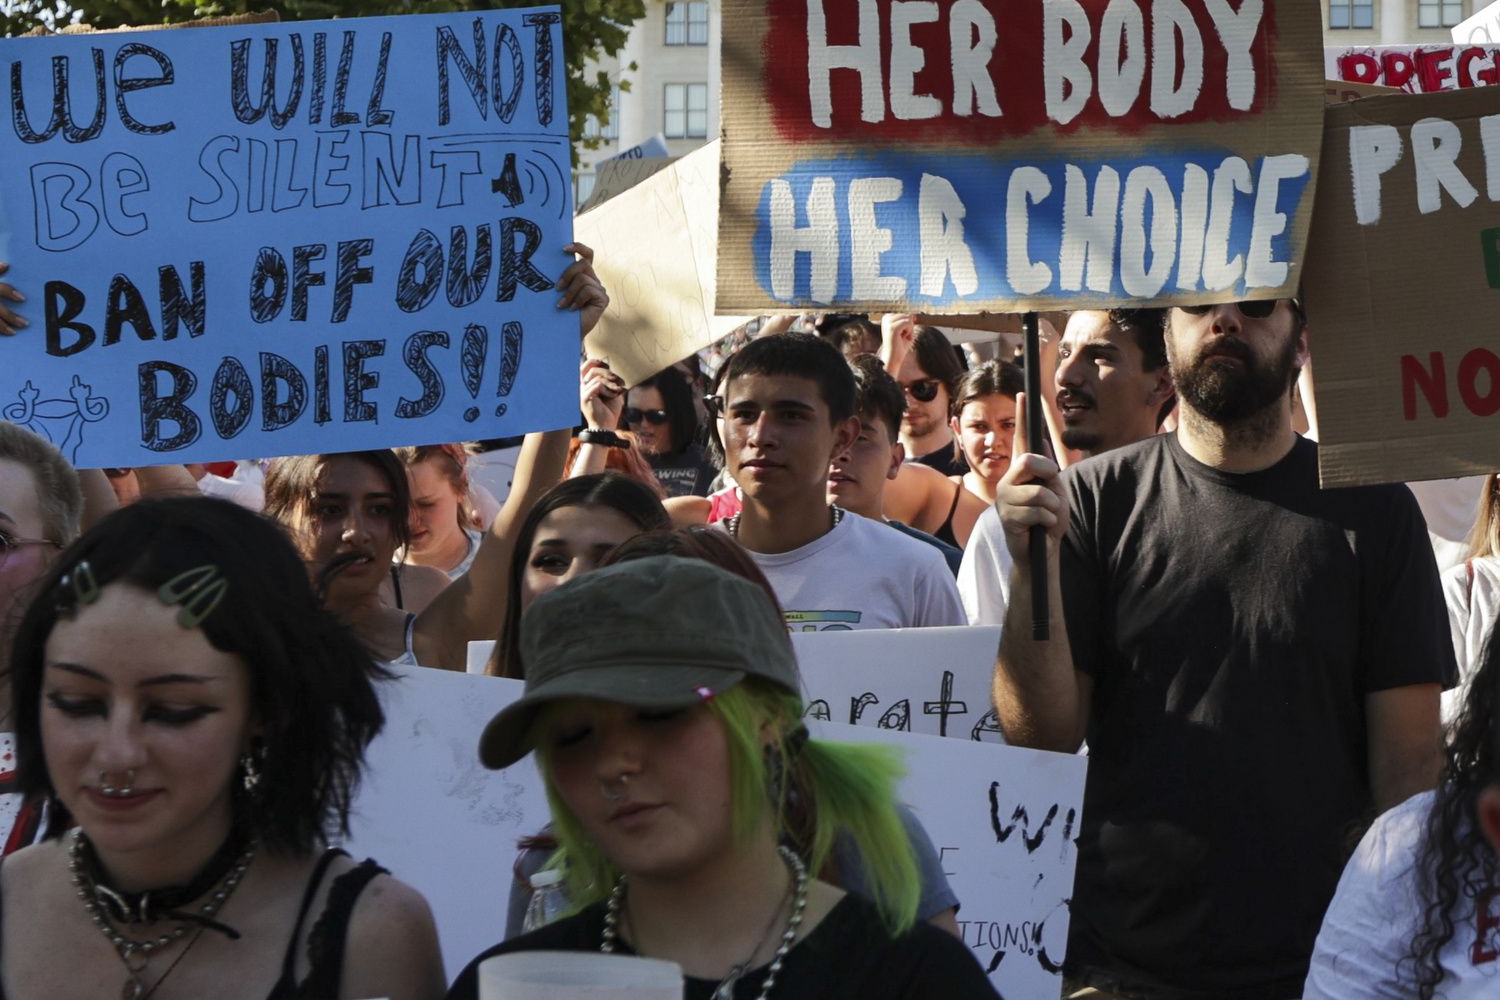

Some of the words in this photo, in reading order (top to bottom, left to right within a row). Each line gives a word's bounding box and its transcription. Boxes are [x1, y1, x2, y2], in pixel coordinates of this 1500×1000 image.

[230, 31, 394, 129] WILL
[436, 12, 561, 127] NOT
[188, 130, 482, 222] SILENT
[769, 173, 979, 305] HER
[1005, 153, 1310, 298] CHOICE
[44, 261, 206, 358] BAN
[250, 239, 374, 325] OFF
[396, 216, 555, 313] OUR
[138, 321, 524, 451] BODIES!!
